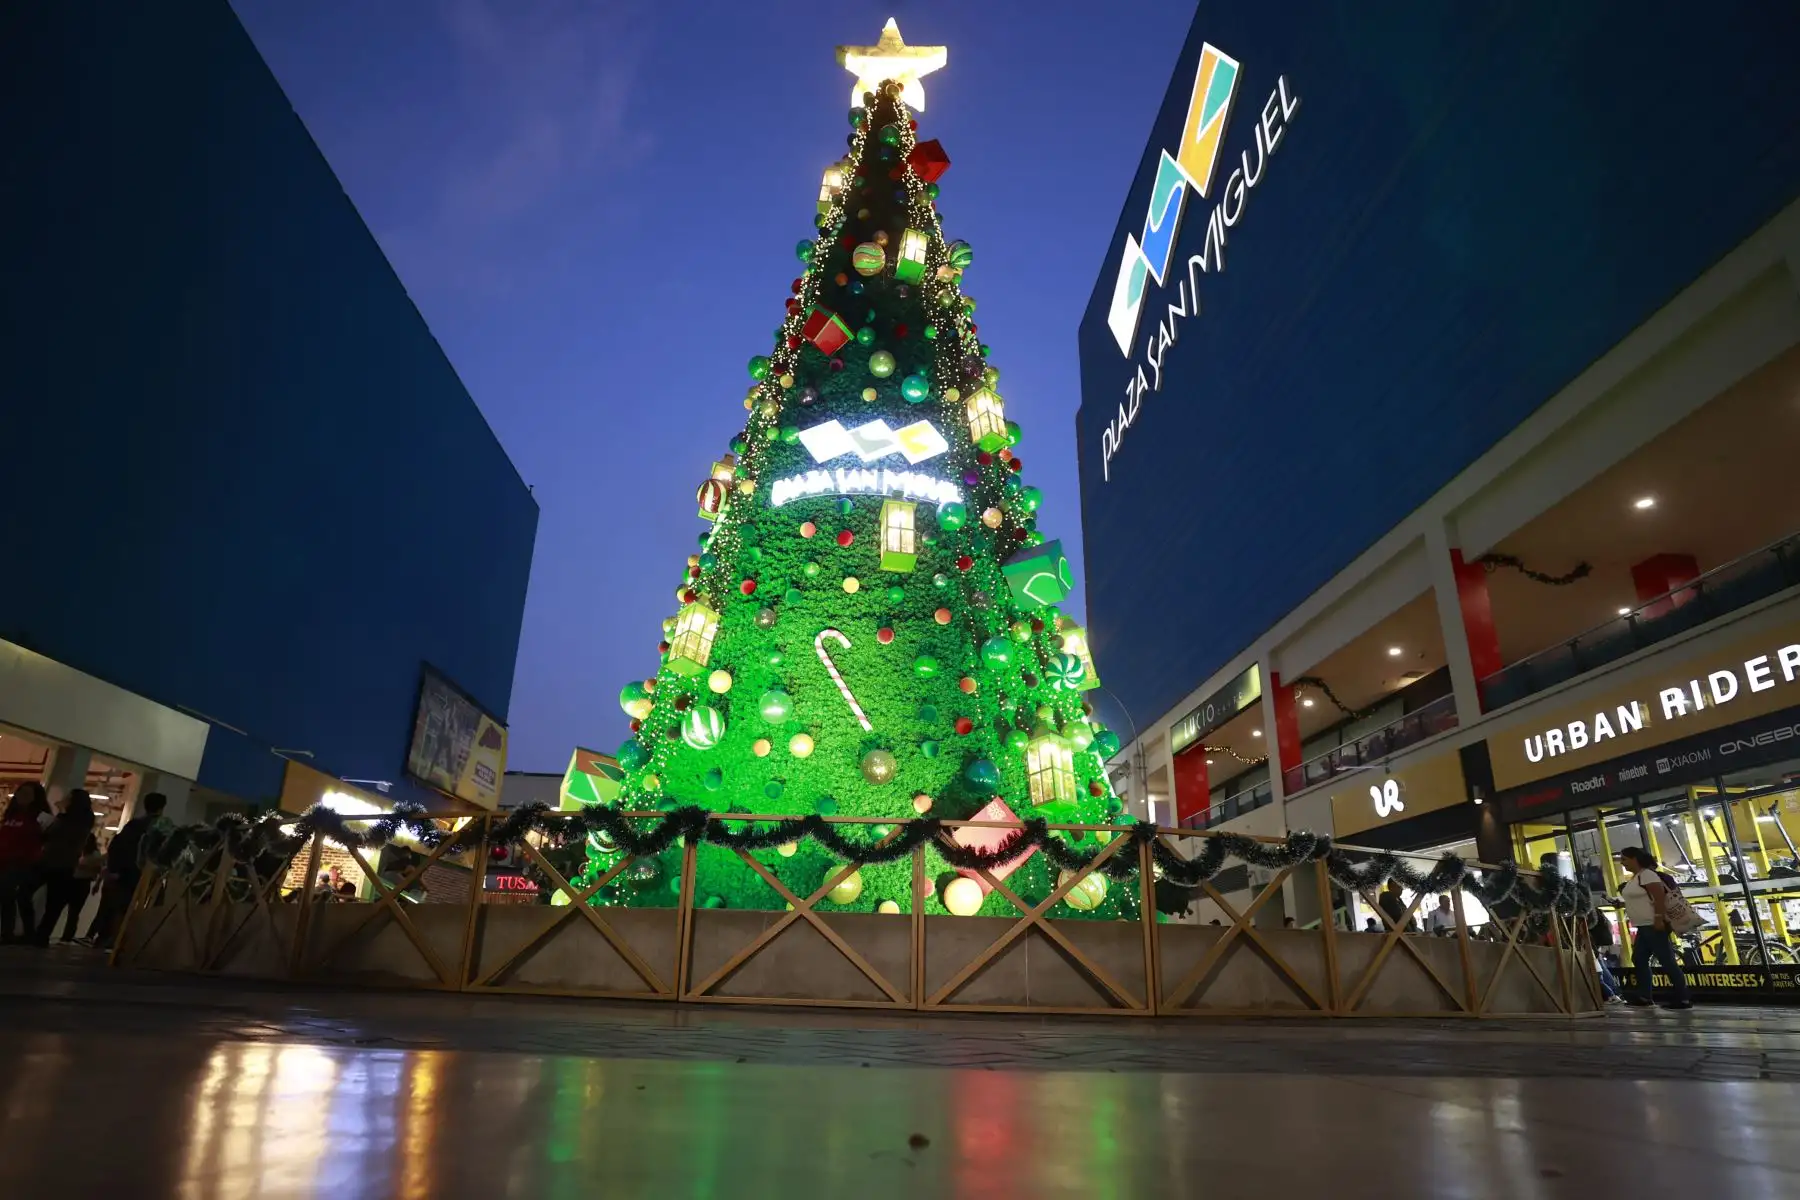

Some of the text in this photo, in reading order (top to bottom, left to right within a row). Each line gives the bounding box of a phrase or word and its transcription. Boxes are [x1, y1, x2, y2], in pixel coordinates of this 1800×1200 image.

[1102, 74, 1298, 482] PLAZA SAN MIGUEL
[1524, 644, 1800, 763] URBAN RIDER
[1183, 703, 1215, 740] LUCIO
[1670, 748, 1712, 769] XIAOMI
[1618, 764, 1648, 783] ninebot
[1683, 973, 1696, 987] IN
[1699, 973, 1758, 988] INTERESES
